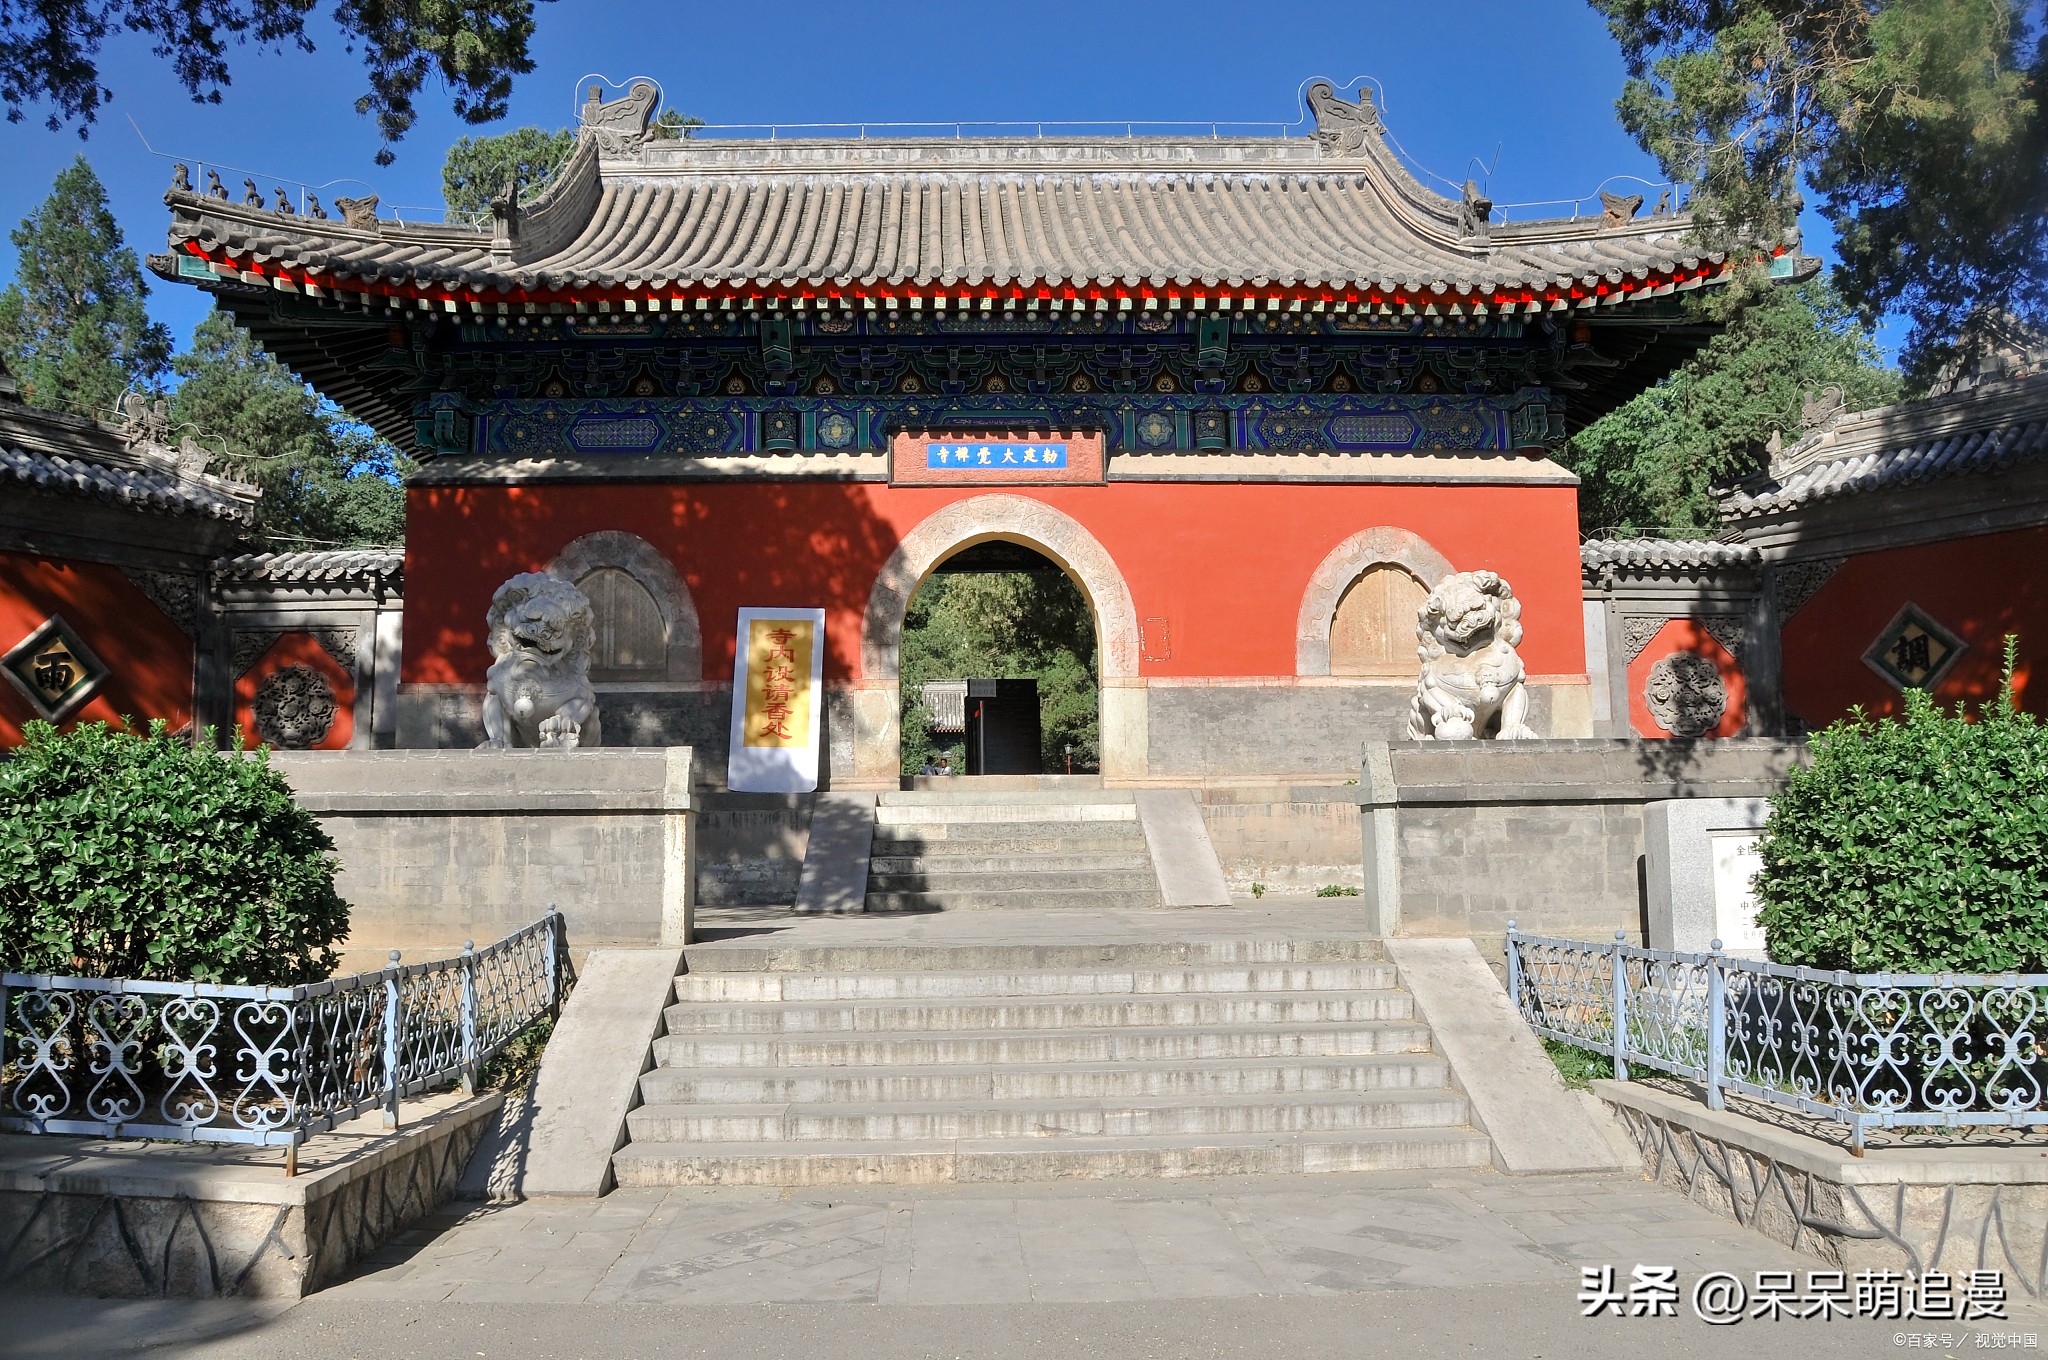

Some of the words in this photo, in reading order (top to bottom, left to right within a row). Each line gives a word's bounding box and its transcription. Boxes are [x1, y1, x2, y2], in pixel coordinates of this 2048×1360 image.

[34, 652, 75, 691] 雨
[759, 628, 797, 740] 寺内设请香处
